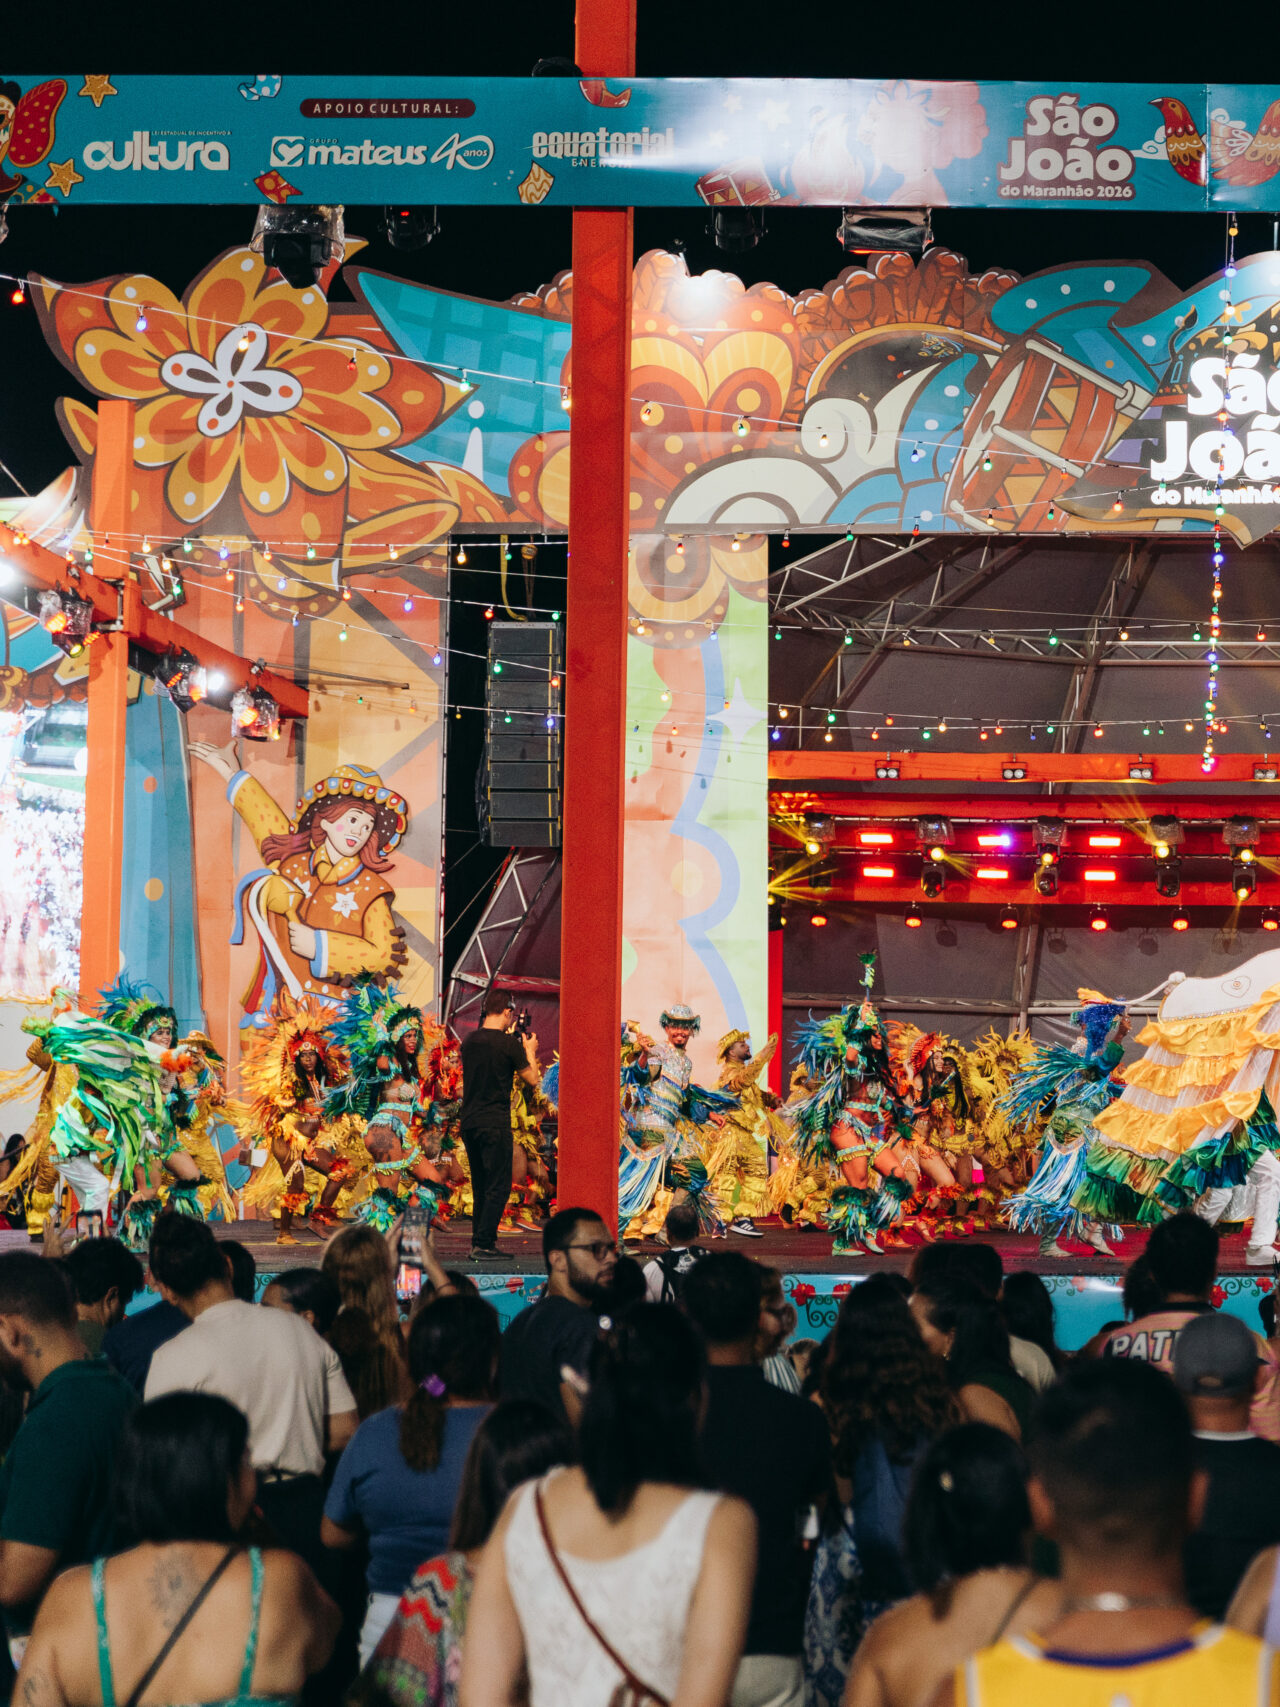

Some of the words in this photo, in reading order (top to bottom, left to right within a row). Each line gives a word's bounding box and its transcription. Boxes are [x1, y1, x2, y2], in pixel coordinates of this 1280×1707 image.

[313, 103, 364, 114] APOIO
[369, 103, 460, 114] CULTURAL:
[1026, 95, 1116, 137] São
[83, 131, 230, 171] cultura
[308, 139, 428, 166] mateus
[463, 148, 488, 157] anos
[532, 127, 675, 159] equatorial
[1000, 136, 1133, 182] João
[1000, 185, 1020, 197] do
[1023, 184, 1094, 197] Maranhão
[1097, 185, 1133, 198] 2026
[1151, 487, 1182, 505] do
[1111, 1329, 1182, 1361] PAT
